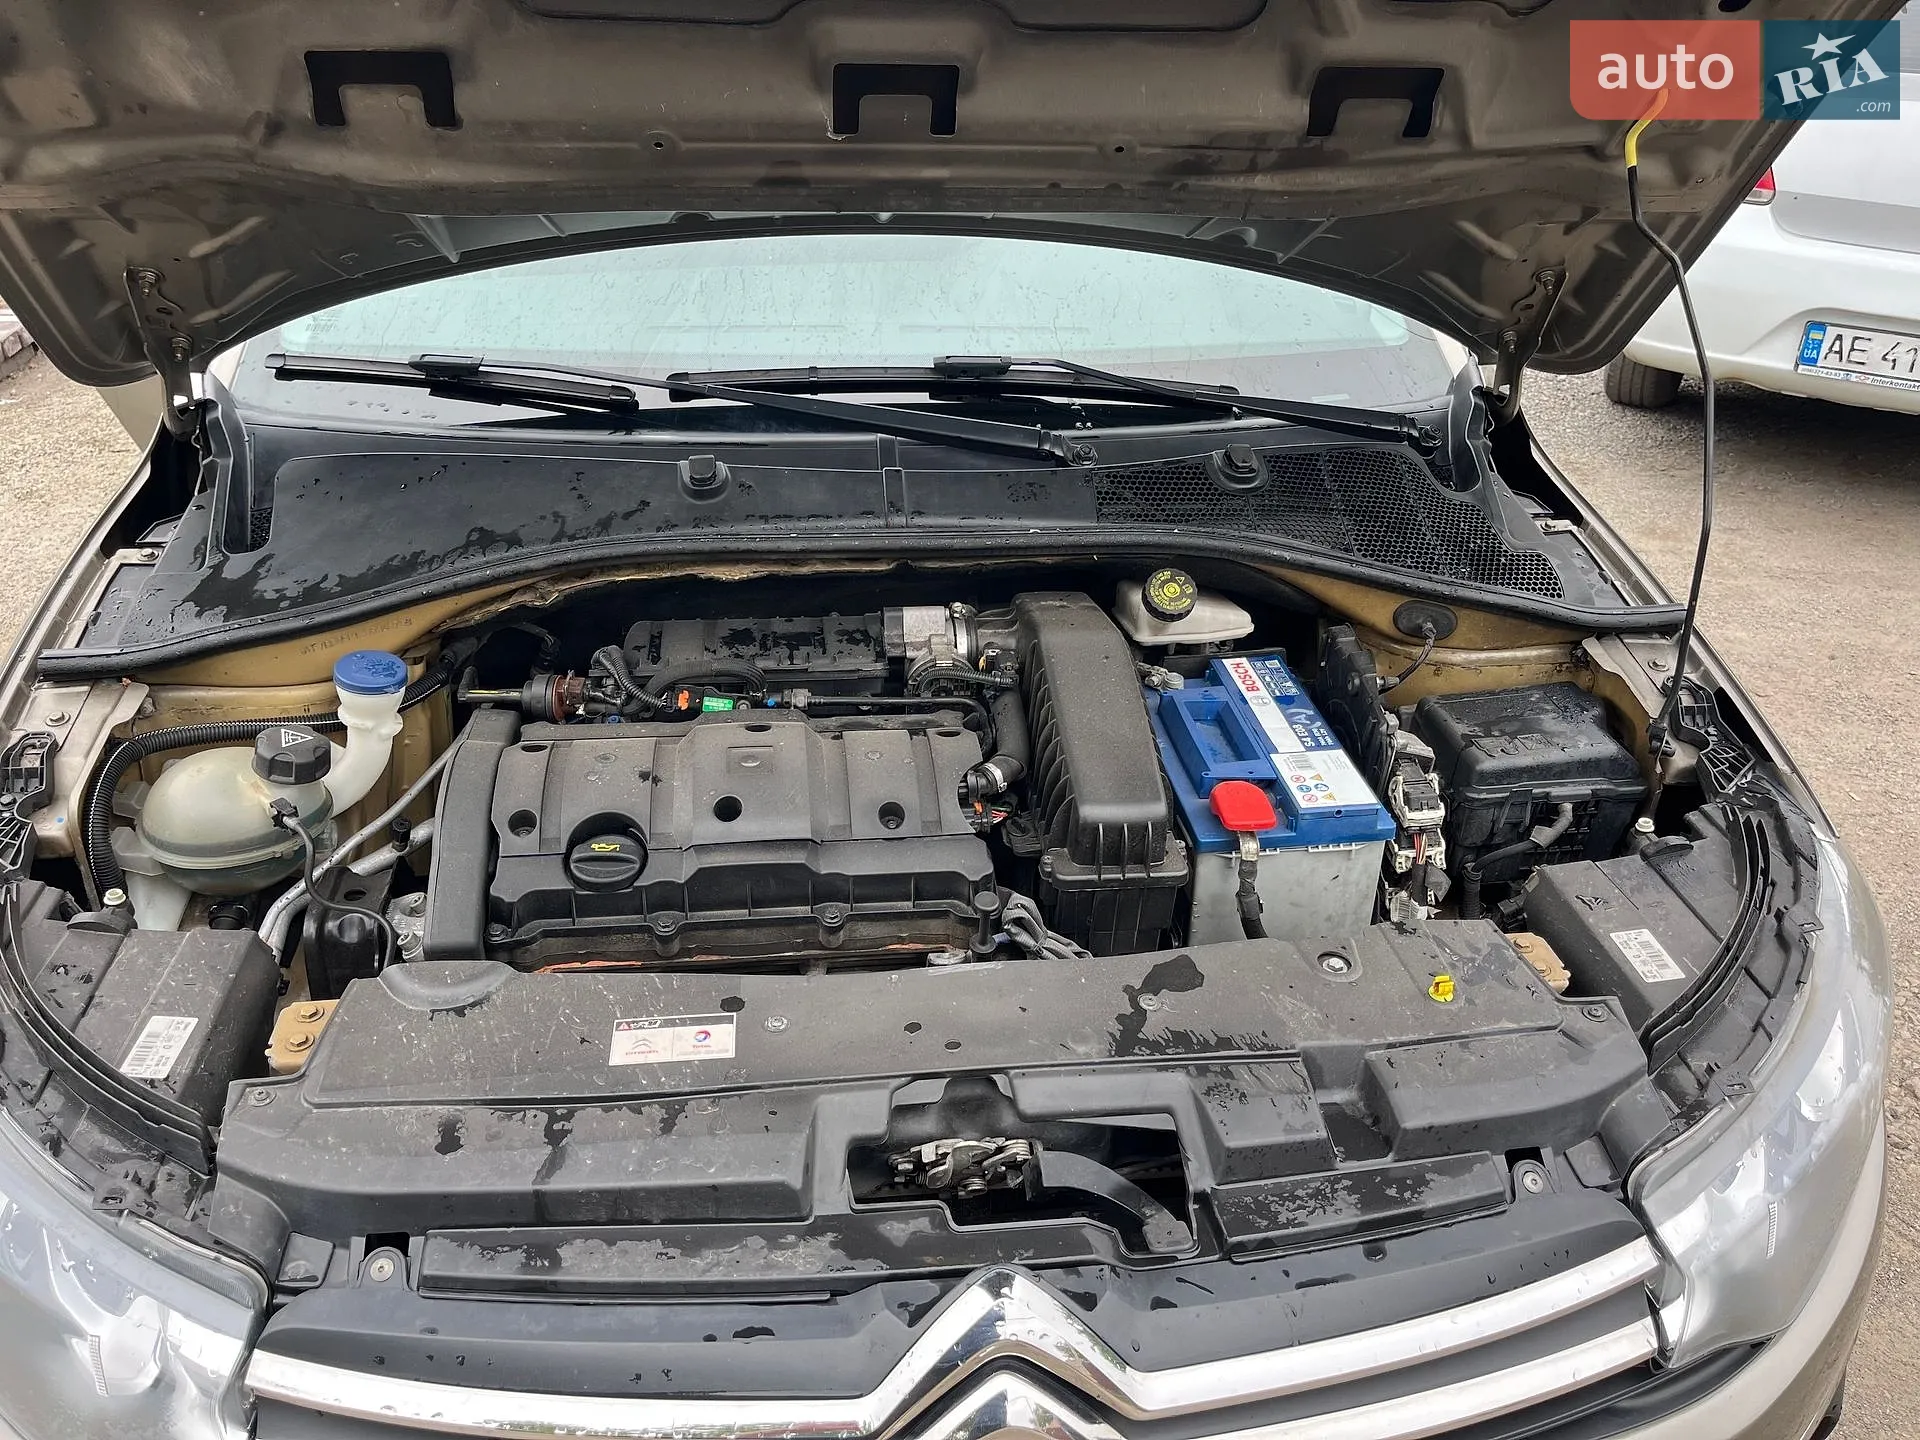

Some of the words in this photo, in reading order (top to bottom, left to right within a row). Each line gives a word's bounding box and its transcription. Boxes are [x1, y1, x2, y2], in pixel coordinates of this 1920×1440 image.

[1803, 349, 1817, 360] UA
[1823, 333, 1872, 366] AE
[1230, 662, 1260, 692] BOSCH
